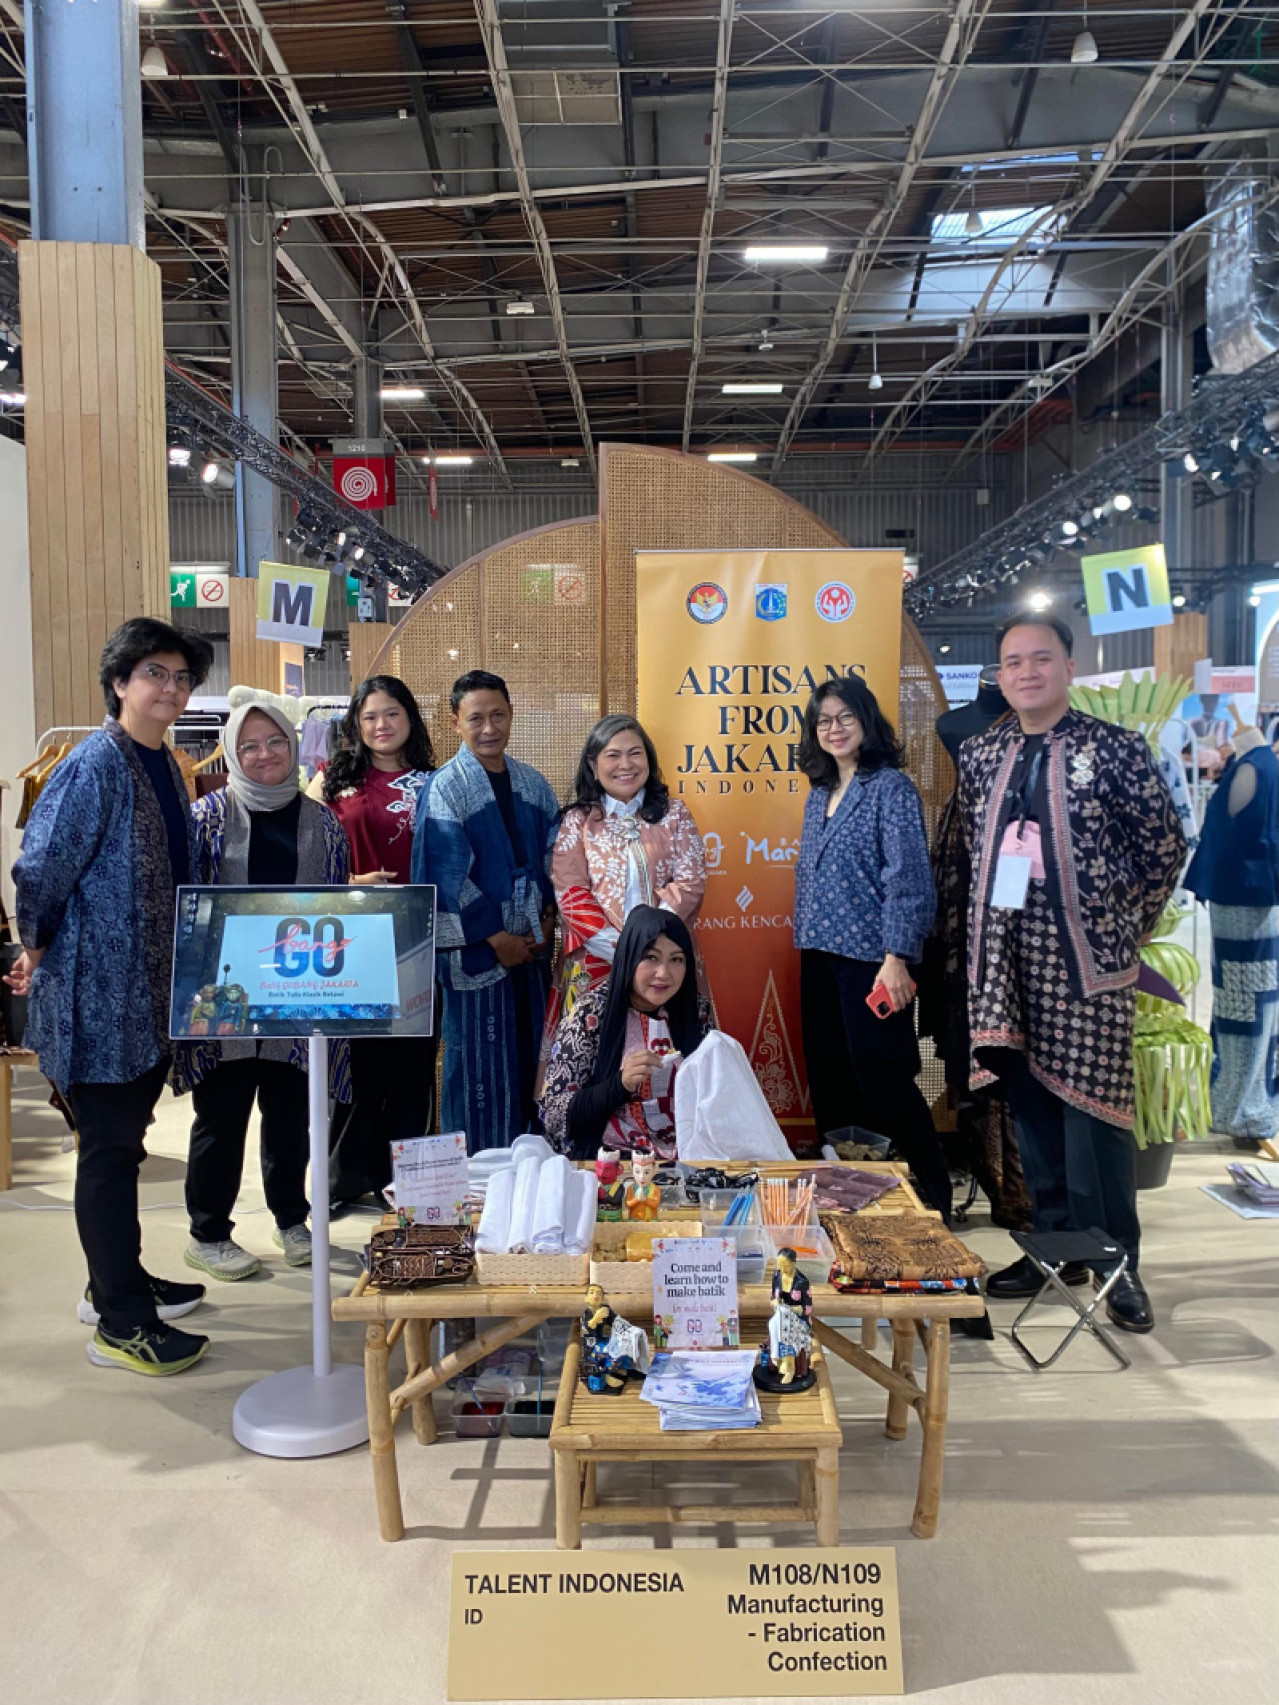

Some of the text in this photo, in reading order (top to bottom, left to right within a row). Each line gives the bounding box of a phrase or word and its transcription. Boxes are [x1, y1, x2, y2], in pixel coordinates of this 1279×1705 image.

[1106, 568, 1149, 612] N
[272, 582, 314, 627] M
[675, 664, 867, 695] ARTISANS
[274, 916, 345, 978] GO
[670, 1260, 722, 1274] Come and
[664, 1273, 730, 1286] learn how to
[666, 1284, 726, 1298] make batik
[464, 1562, 882, 1595] TALENT INDONESIA M108/N109
[464, 1608, 483, 1625] ID
[727, 1593, 884, 1619] Manufacturing
[763, 1621, 886, 1643] Fabrication
[767, 1650, 888, 1672] Confection
